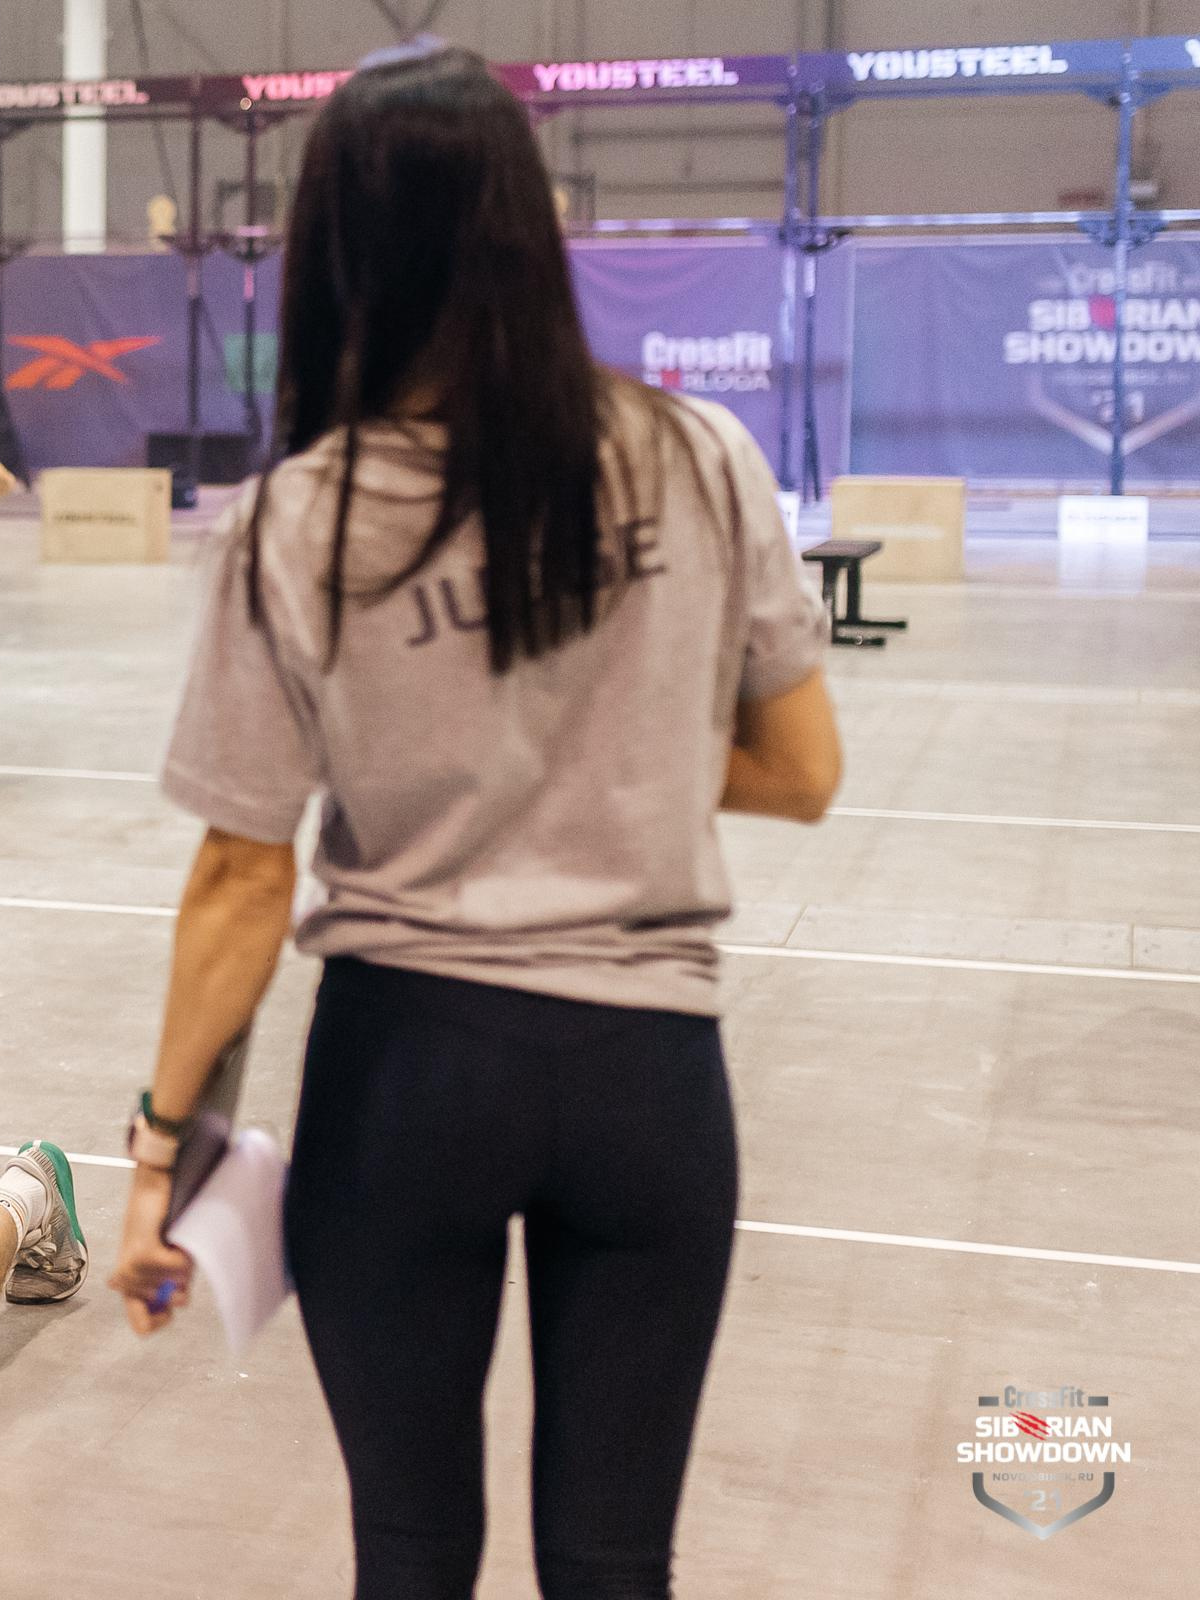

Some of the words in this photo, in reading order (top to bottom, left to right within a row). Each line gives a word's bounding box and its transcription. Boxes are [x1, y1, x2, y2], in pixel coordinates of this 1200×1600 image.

[1029, 298, 1200, 331] SIBRIA
[642, 331, 771, 371] CrossFit
[1003, 331, 1200, 364] SHOWDOW
[405, 517, 668, 649] JUE
